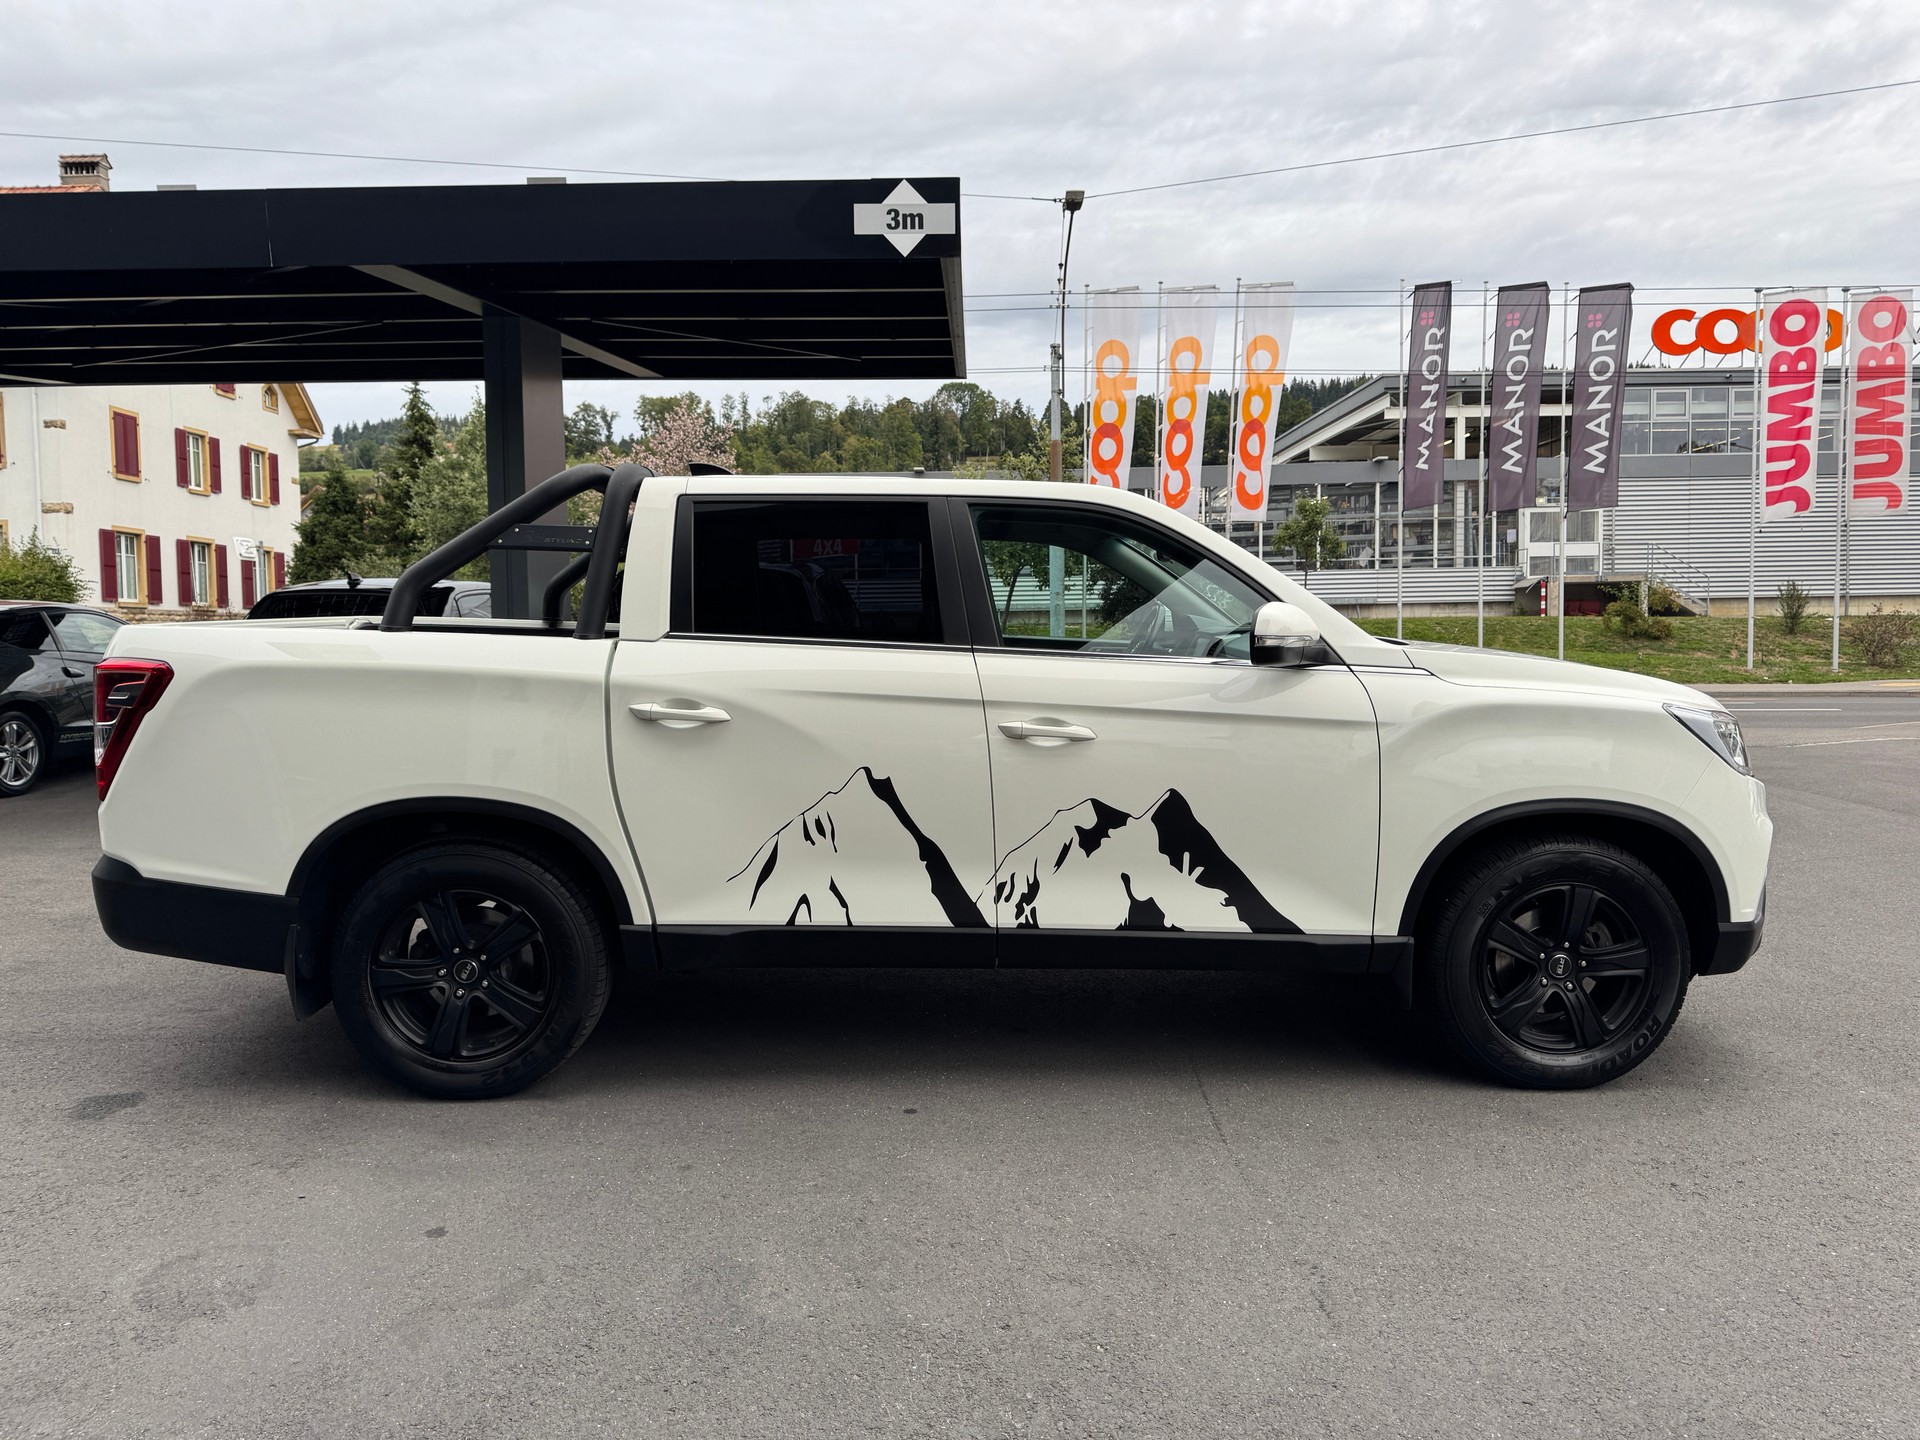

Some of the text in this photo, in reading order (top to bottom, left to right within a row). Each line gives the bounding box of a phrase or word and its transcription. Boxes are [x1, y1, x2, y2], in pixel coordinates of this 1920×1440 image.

[886, 208, 924, 230] 3m
[1415, 326, 1445, 470] MANOR
[1501, 327, 1534, 473] MANOR
[1583, 327, 1618, 473] MANOR
[1765, 298, 1821, 513] JUMBO
[1853, 296, 1907, 510] JUMBO
